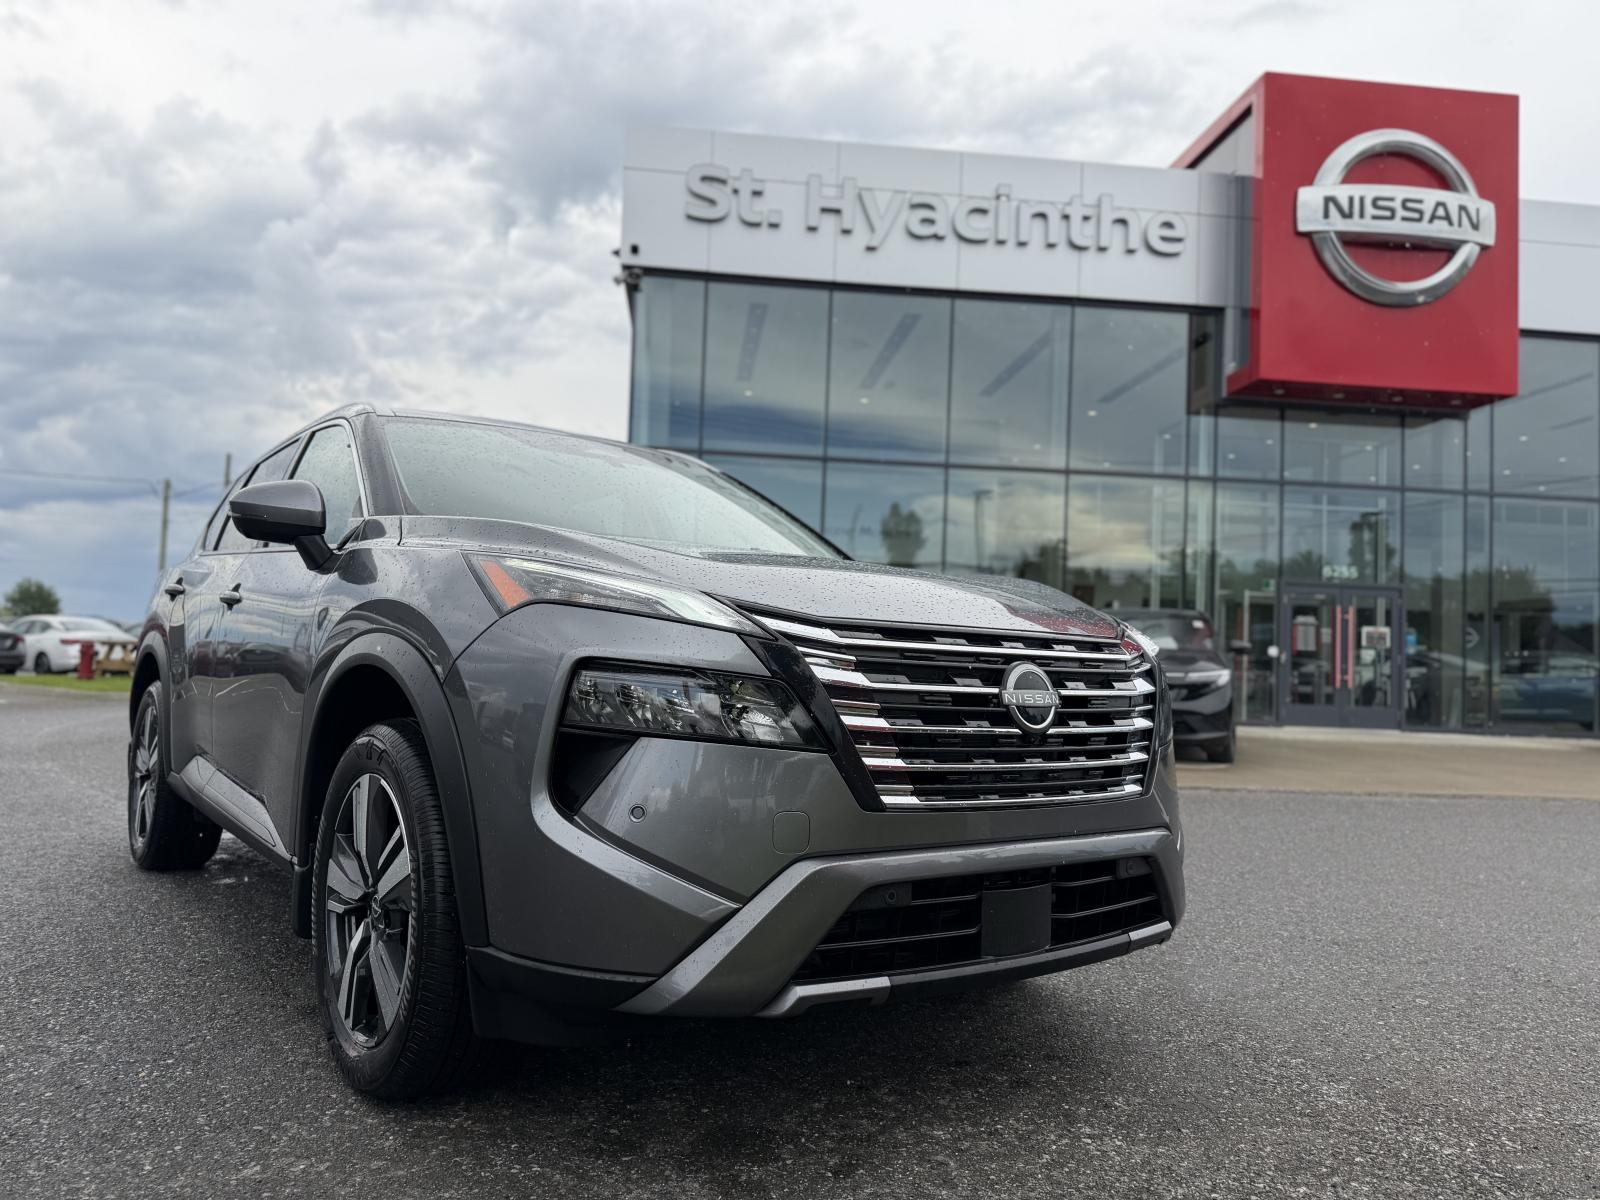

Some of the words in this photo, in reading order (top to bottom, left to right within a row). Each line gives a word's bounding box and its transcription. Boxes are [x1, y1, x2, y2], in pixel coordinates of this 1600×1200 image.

[684, 163, 782, 228] St.
[805, 174, 1188, 257] Hyacinthe
[1322, 195, 1480, 232] NISSAN
[1004, 692, 1059, 704] NISSAN
